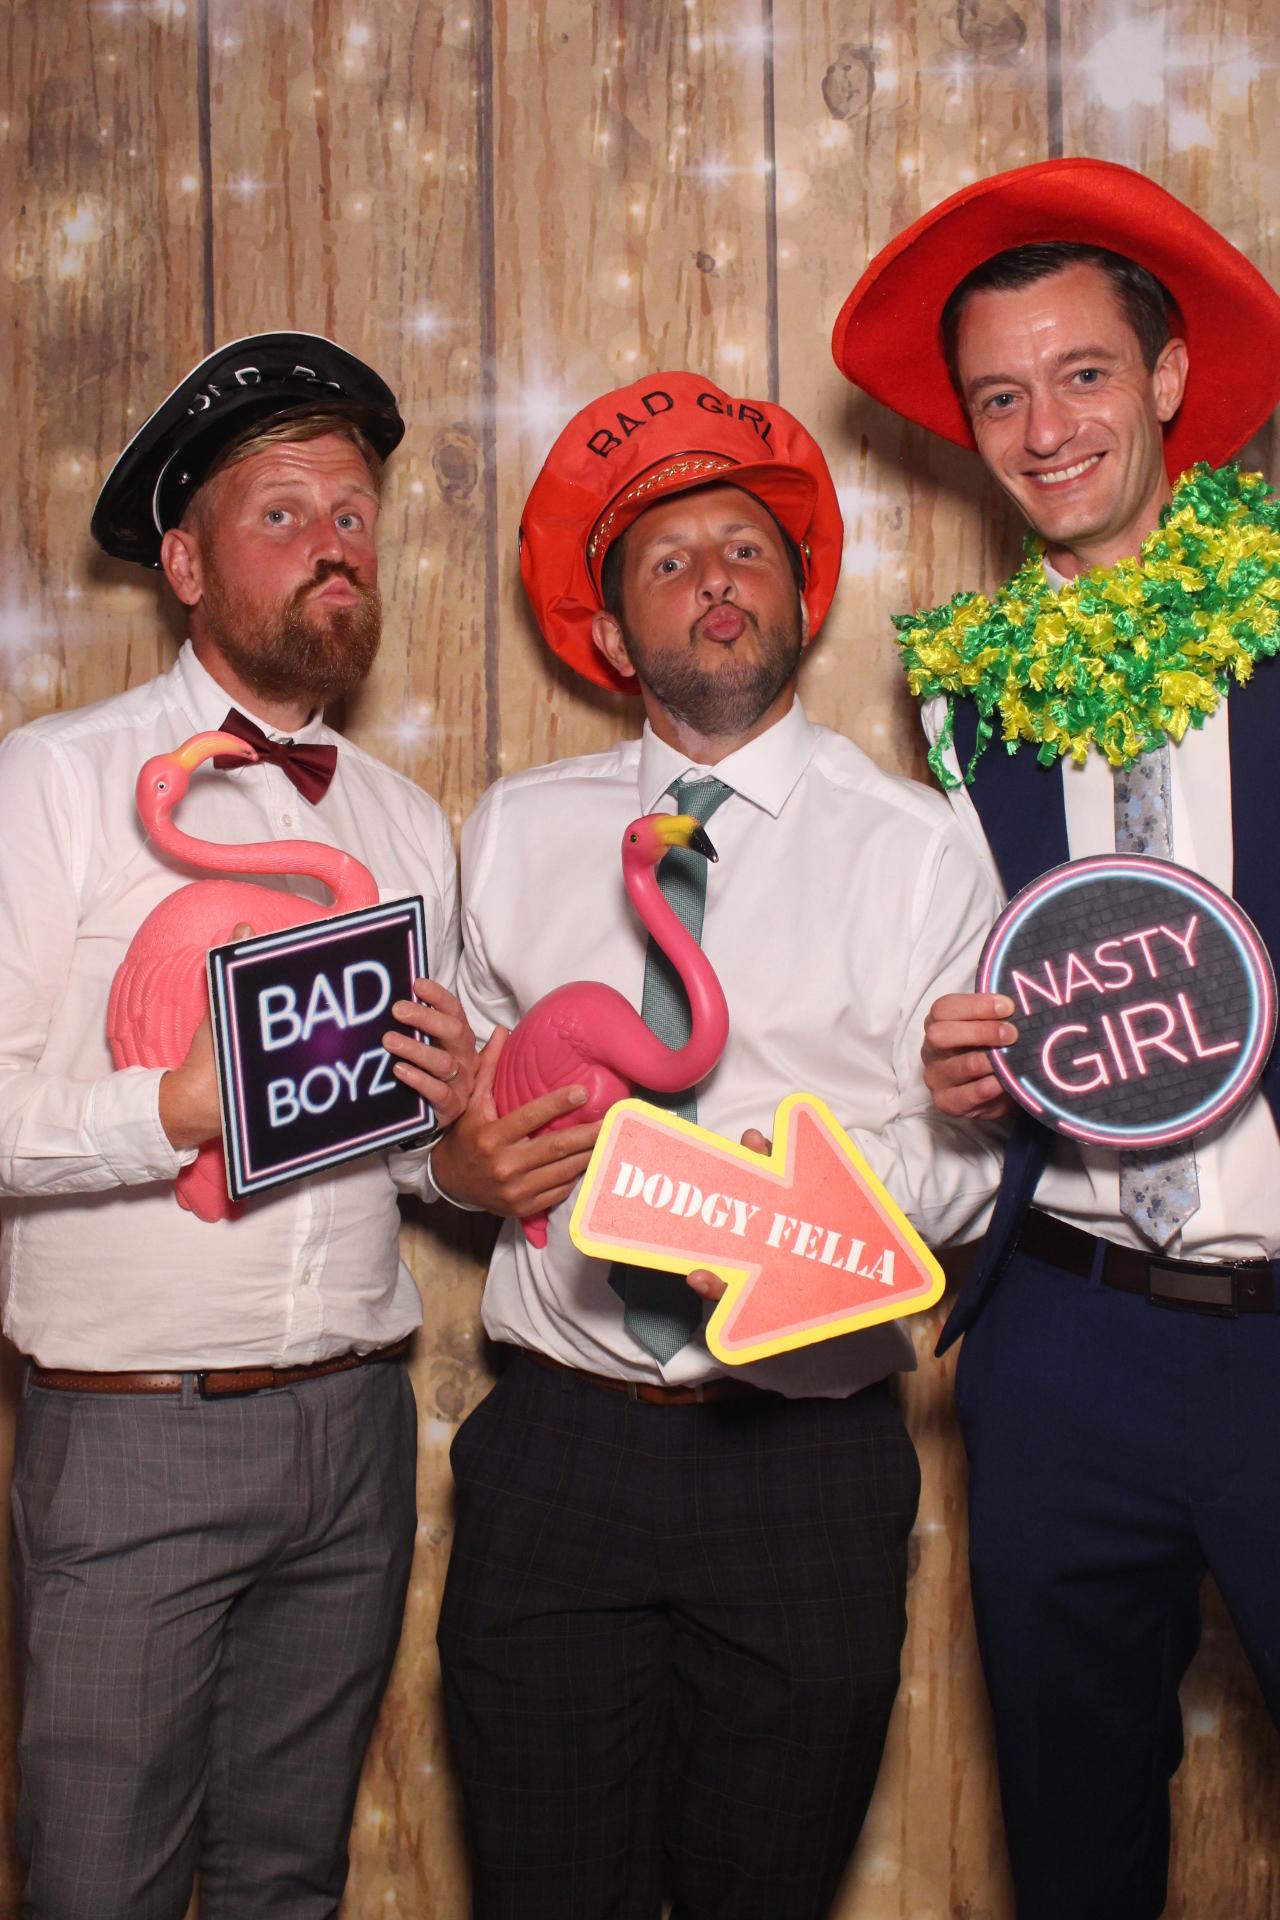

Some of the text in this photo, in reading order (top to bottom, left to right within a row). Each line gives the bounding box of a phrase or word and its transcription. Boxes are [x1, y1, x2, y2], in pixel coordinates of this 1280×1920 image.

[586, 391, 775, 459] BAD GIRL
[258, 960, 391, 1051] BAD
[1011, 915, 1198, 1015] NASTY
[267, 1047, 396, 1128] BOYZ
[1042, 993, 1240, 1092] GIRL
[611, 1161, 897, 1286] DODGY FELLA
